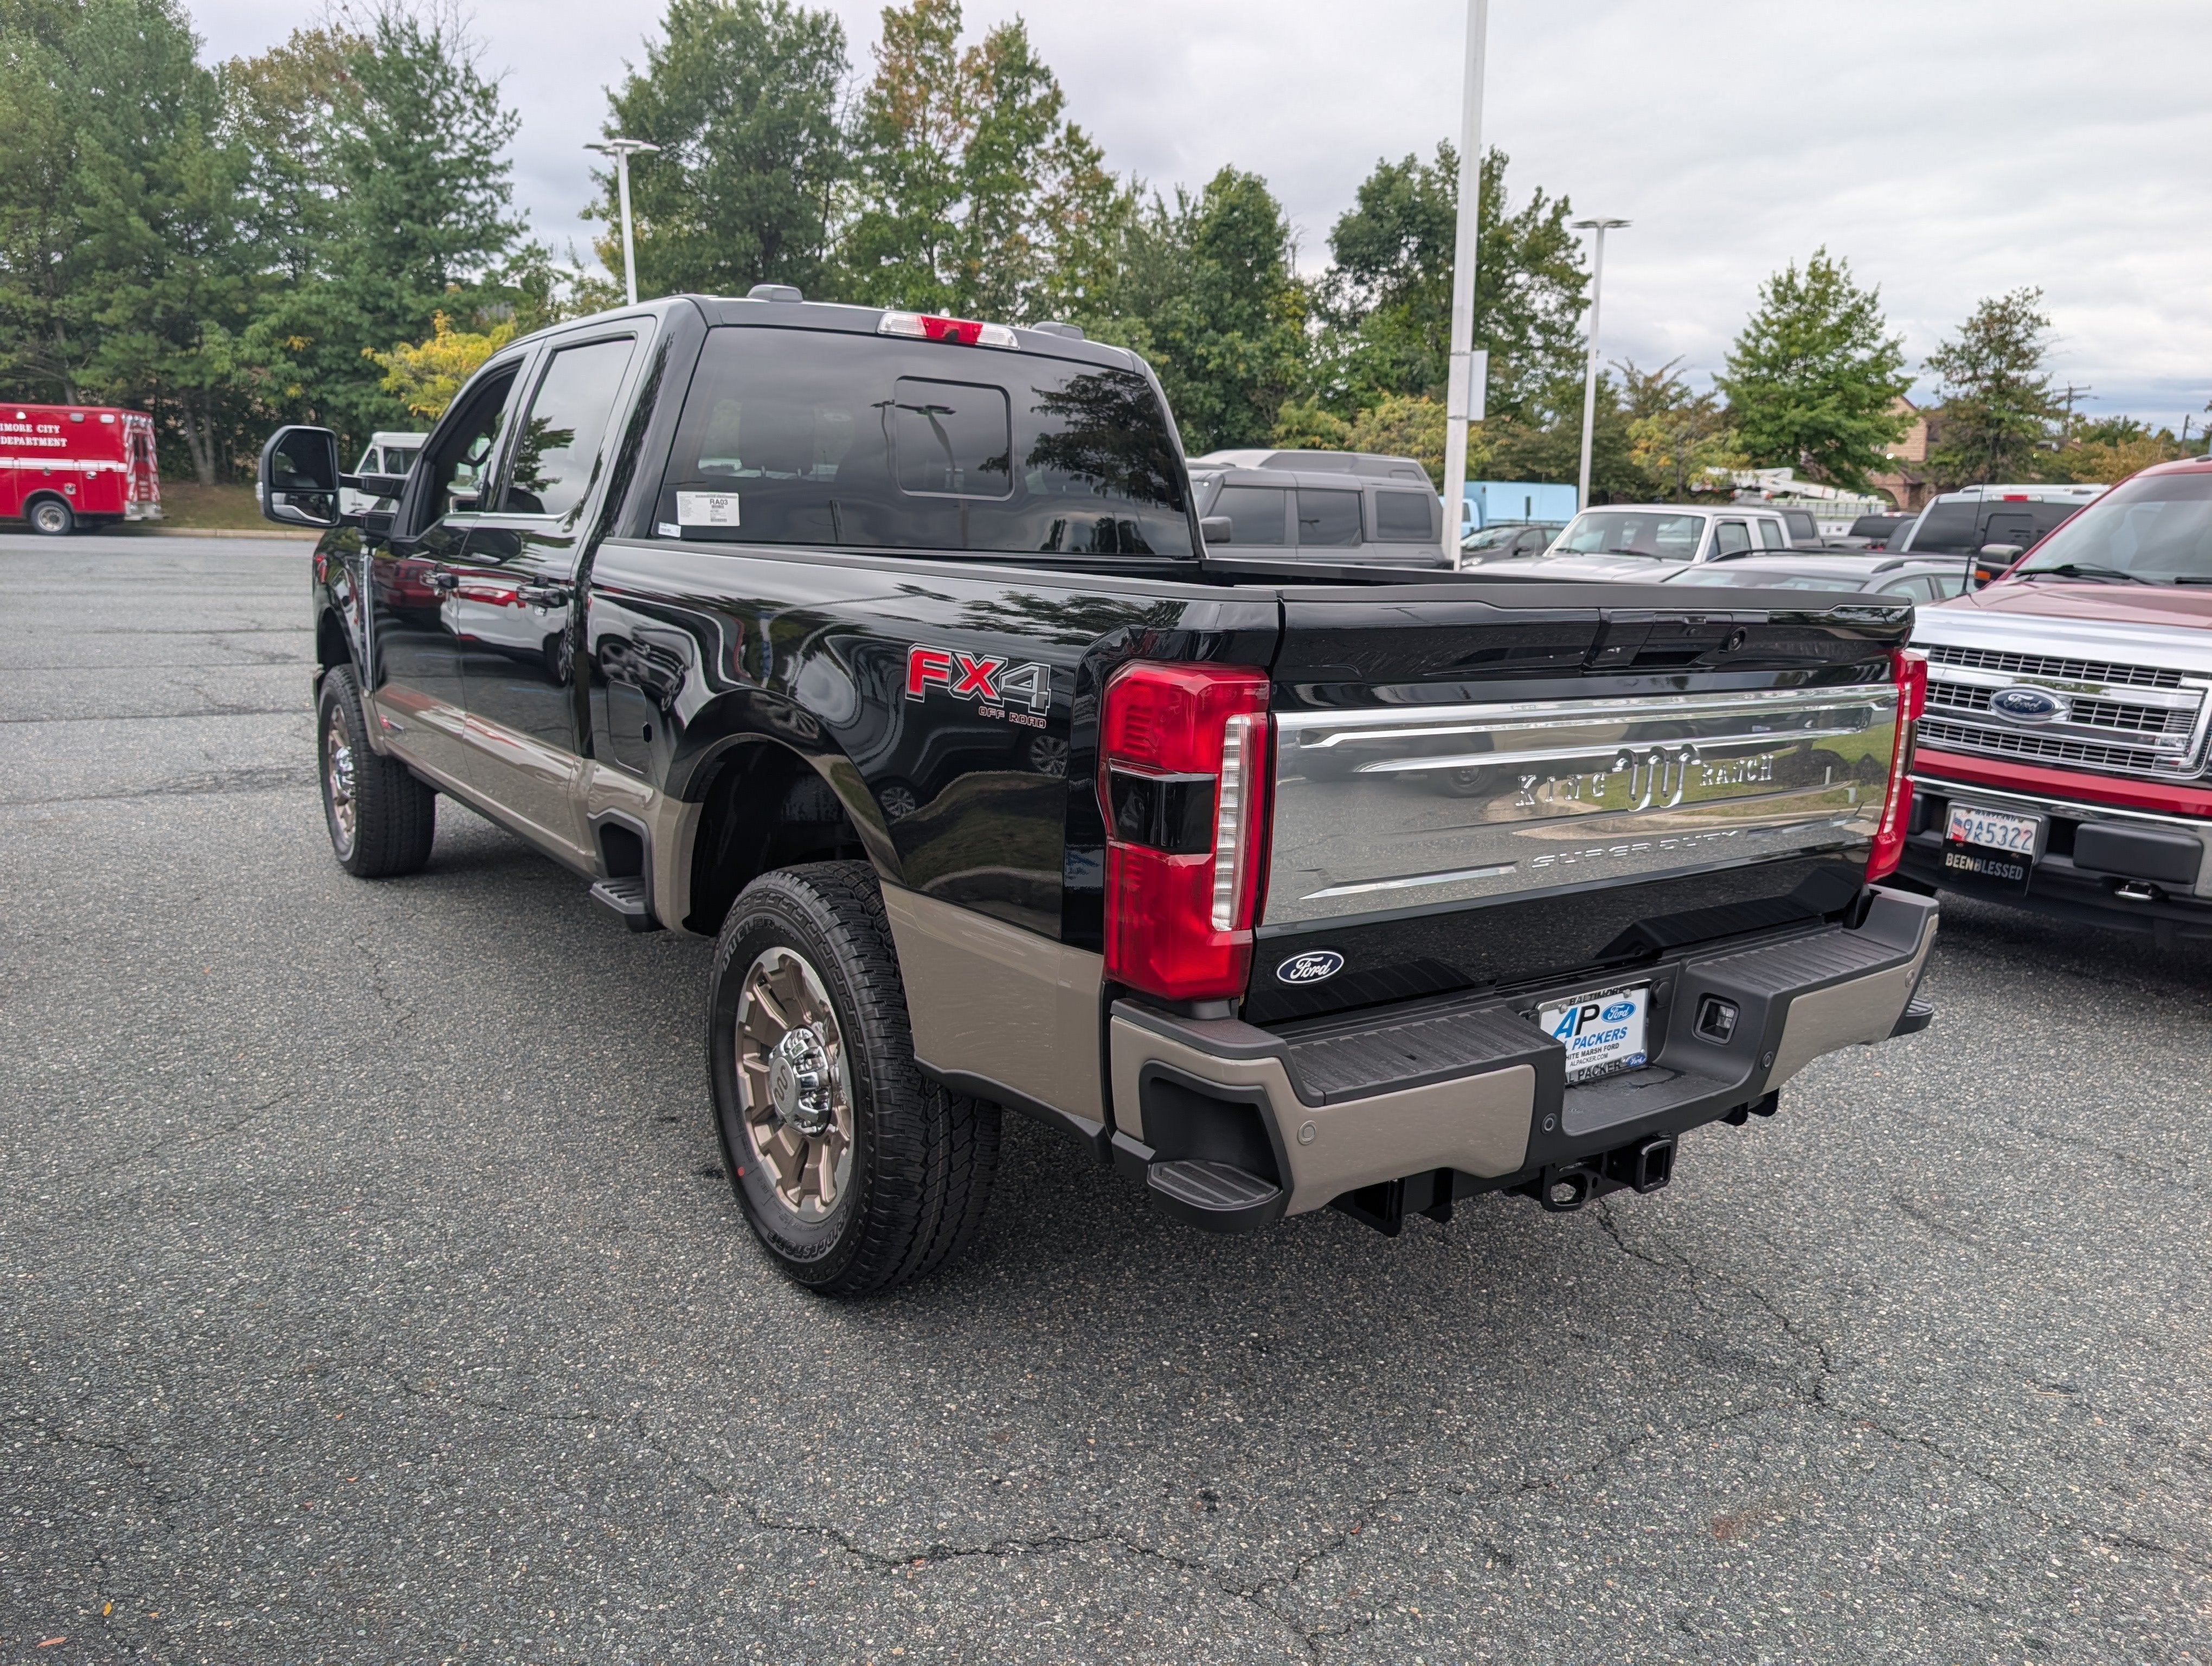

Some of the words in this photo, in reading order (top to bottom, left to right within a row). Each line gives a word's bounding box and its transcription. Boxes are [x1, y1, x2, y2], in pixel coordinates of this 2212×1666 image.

[36, 424, 61, 434] CITY
[0, 436, 67, 447] DEPARTMENT
[905, 643, 1051, 716] FX4
[2003, 693, 2042, 712] Ford
[979, 706, 1005, 719] OFF
[1009, 712, 1047, 729] ROAD
[1515, 772, 1606, 806] KING
[1699, 753, 1774, 786] RANCH
[1290, 956, 1333, 979] Ford
[1570, 987, 1623, 1005] BALTIMORE
[1552, 1004, 1600, 1039] AP
[1607, 1004, 1630, 1020] Ford
[1571, 1026, 1628, 1050] PACKERS
[1566, 1052, 1579, 1061] HITE
[1580, 1046, 1602, 1058] MARSH
[1603, 1042, 1619, 1054] FORD
[1570, 1052, 1608, 1067] ALPACKER.COM
[1578, 1059, 1621, 1080] PACKER
